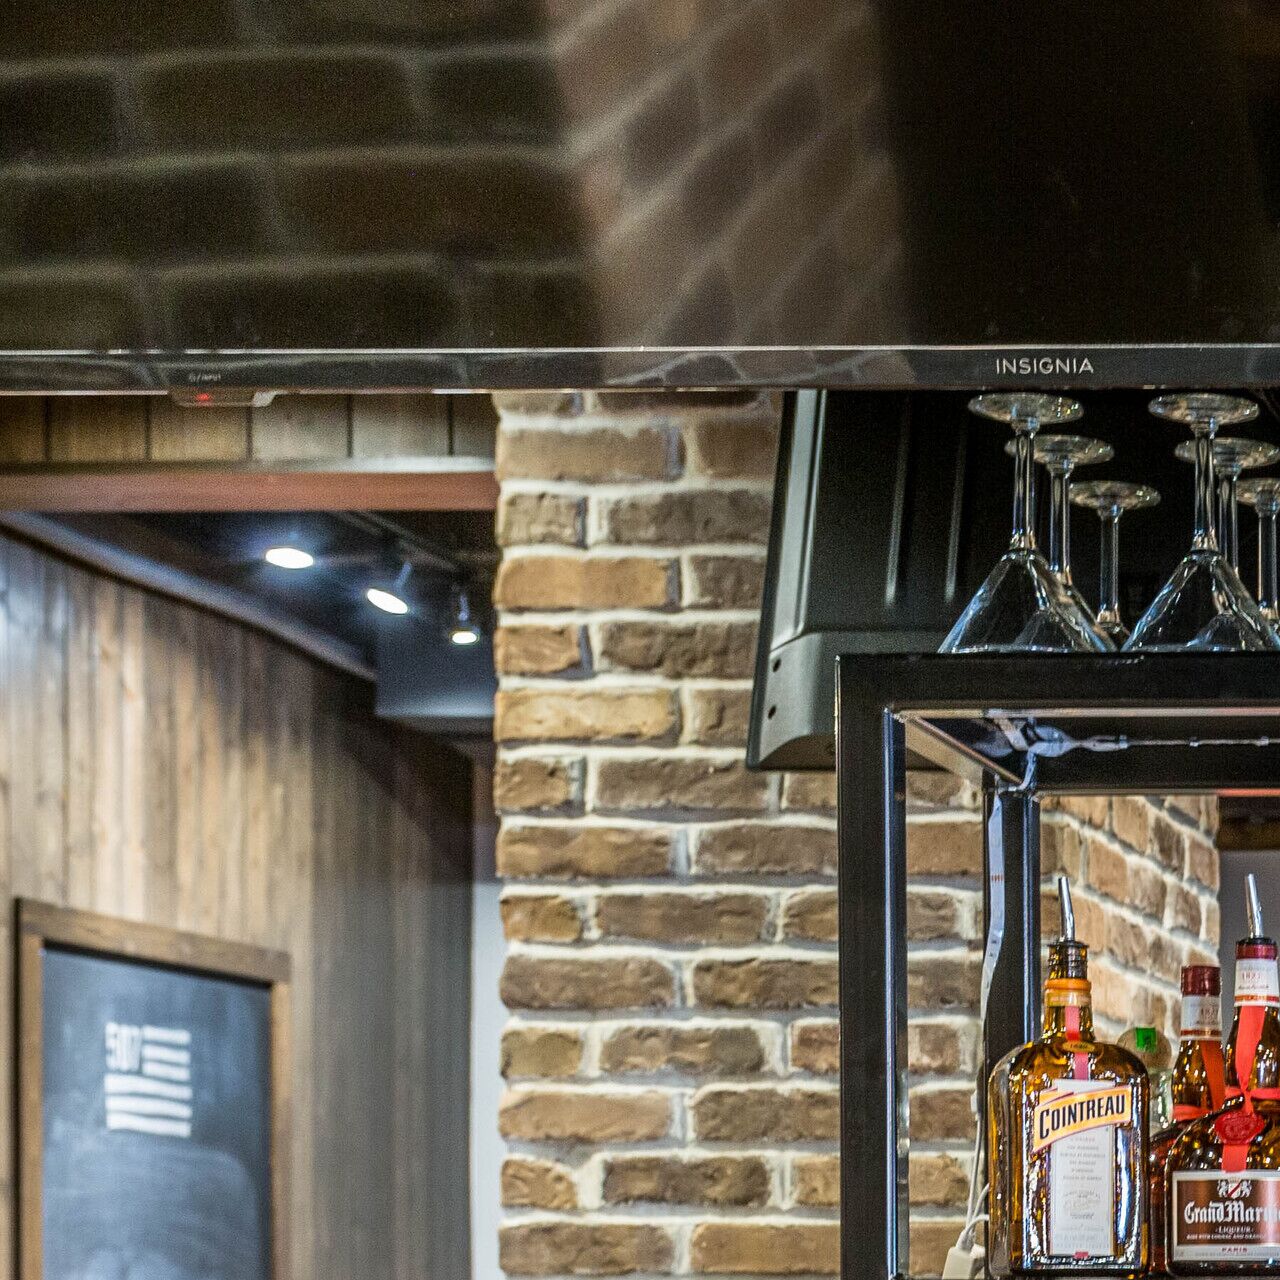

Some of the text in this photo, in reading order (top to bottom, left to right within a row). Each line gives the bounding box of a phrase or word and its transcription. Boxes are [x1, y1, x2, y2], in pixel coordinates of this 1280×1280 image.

[995, 357, 1094, 375] INSIGNIA
[1038, 1092, 1127, 1140] COINTREAU
[1184, 1200, 1224, 1224] Grand
